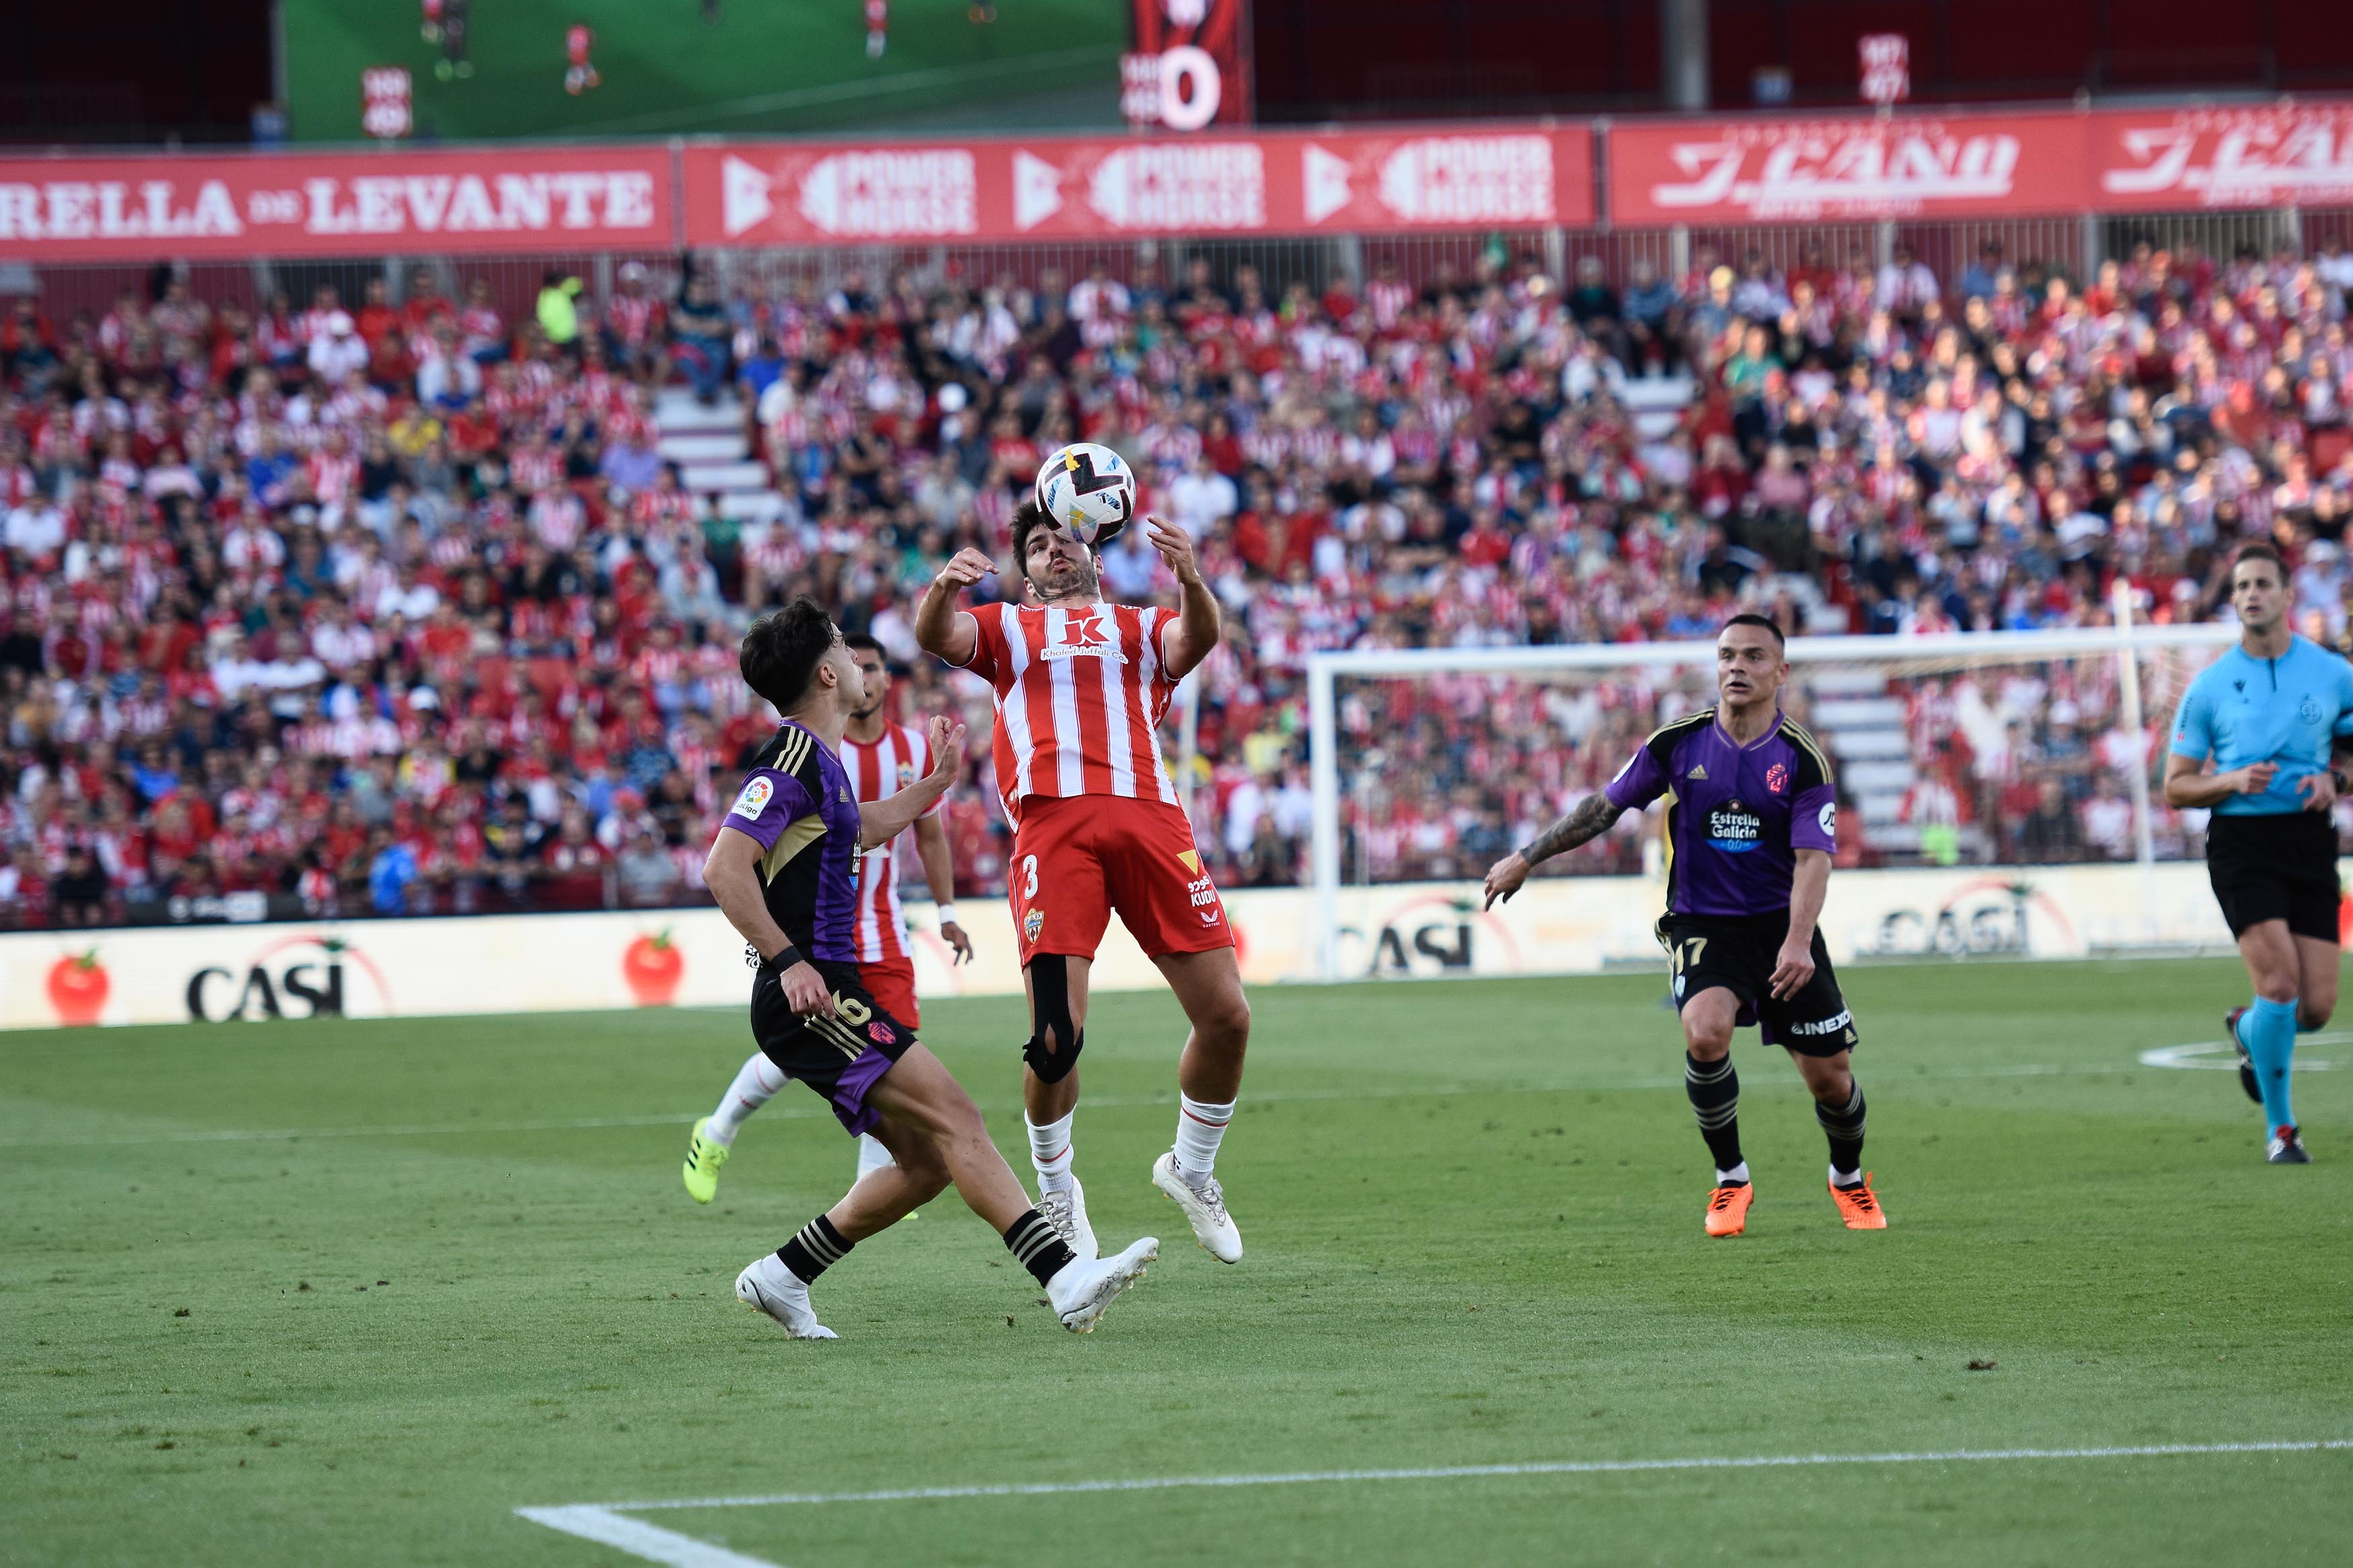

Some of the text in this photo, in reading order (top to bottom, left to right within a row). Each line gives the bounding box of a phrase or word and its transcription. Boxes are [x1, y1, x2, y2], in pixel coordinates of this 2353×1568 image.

[1158, 45, 1222, 131] 0
[306, 171, 654, 235] LEVANTE
[1043, 647, 1127, 663] Khaled Juffali Co.
[736, 802, 758, 815] LaLiga
[1710, 811, 1760, 827] Estrella
[1712, 825, 1757, 839] Galicia
[1023, 854, 1039, 900] 3
[1191, 889, 1216, 907] KUDU
[186, 962, 344, 1022] CASI
[832, 989, 872, 1026] 6
